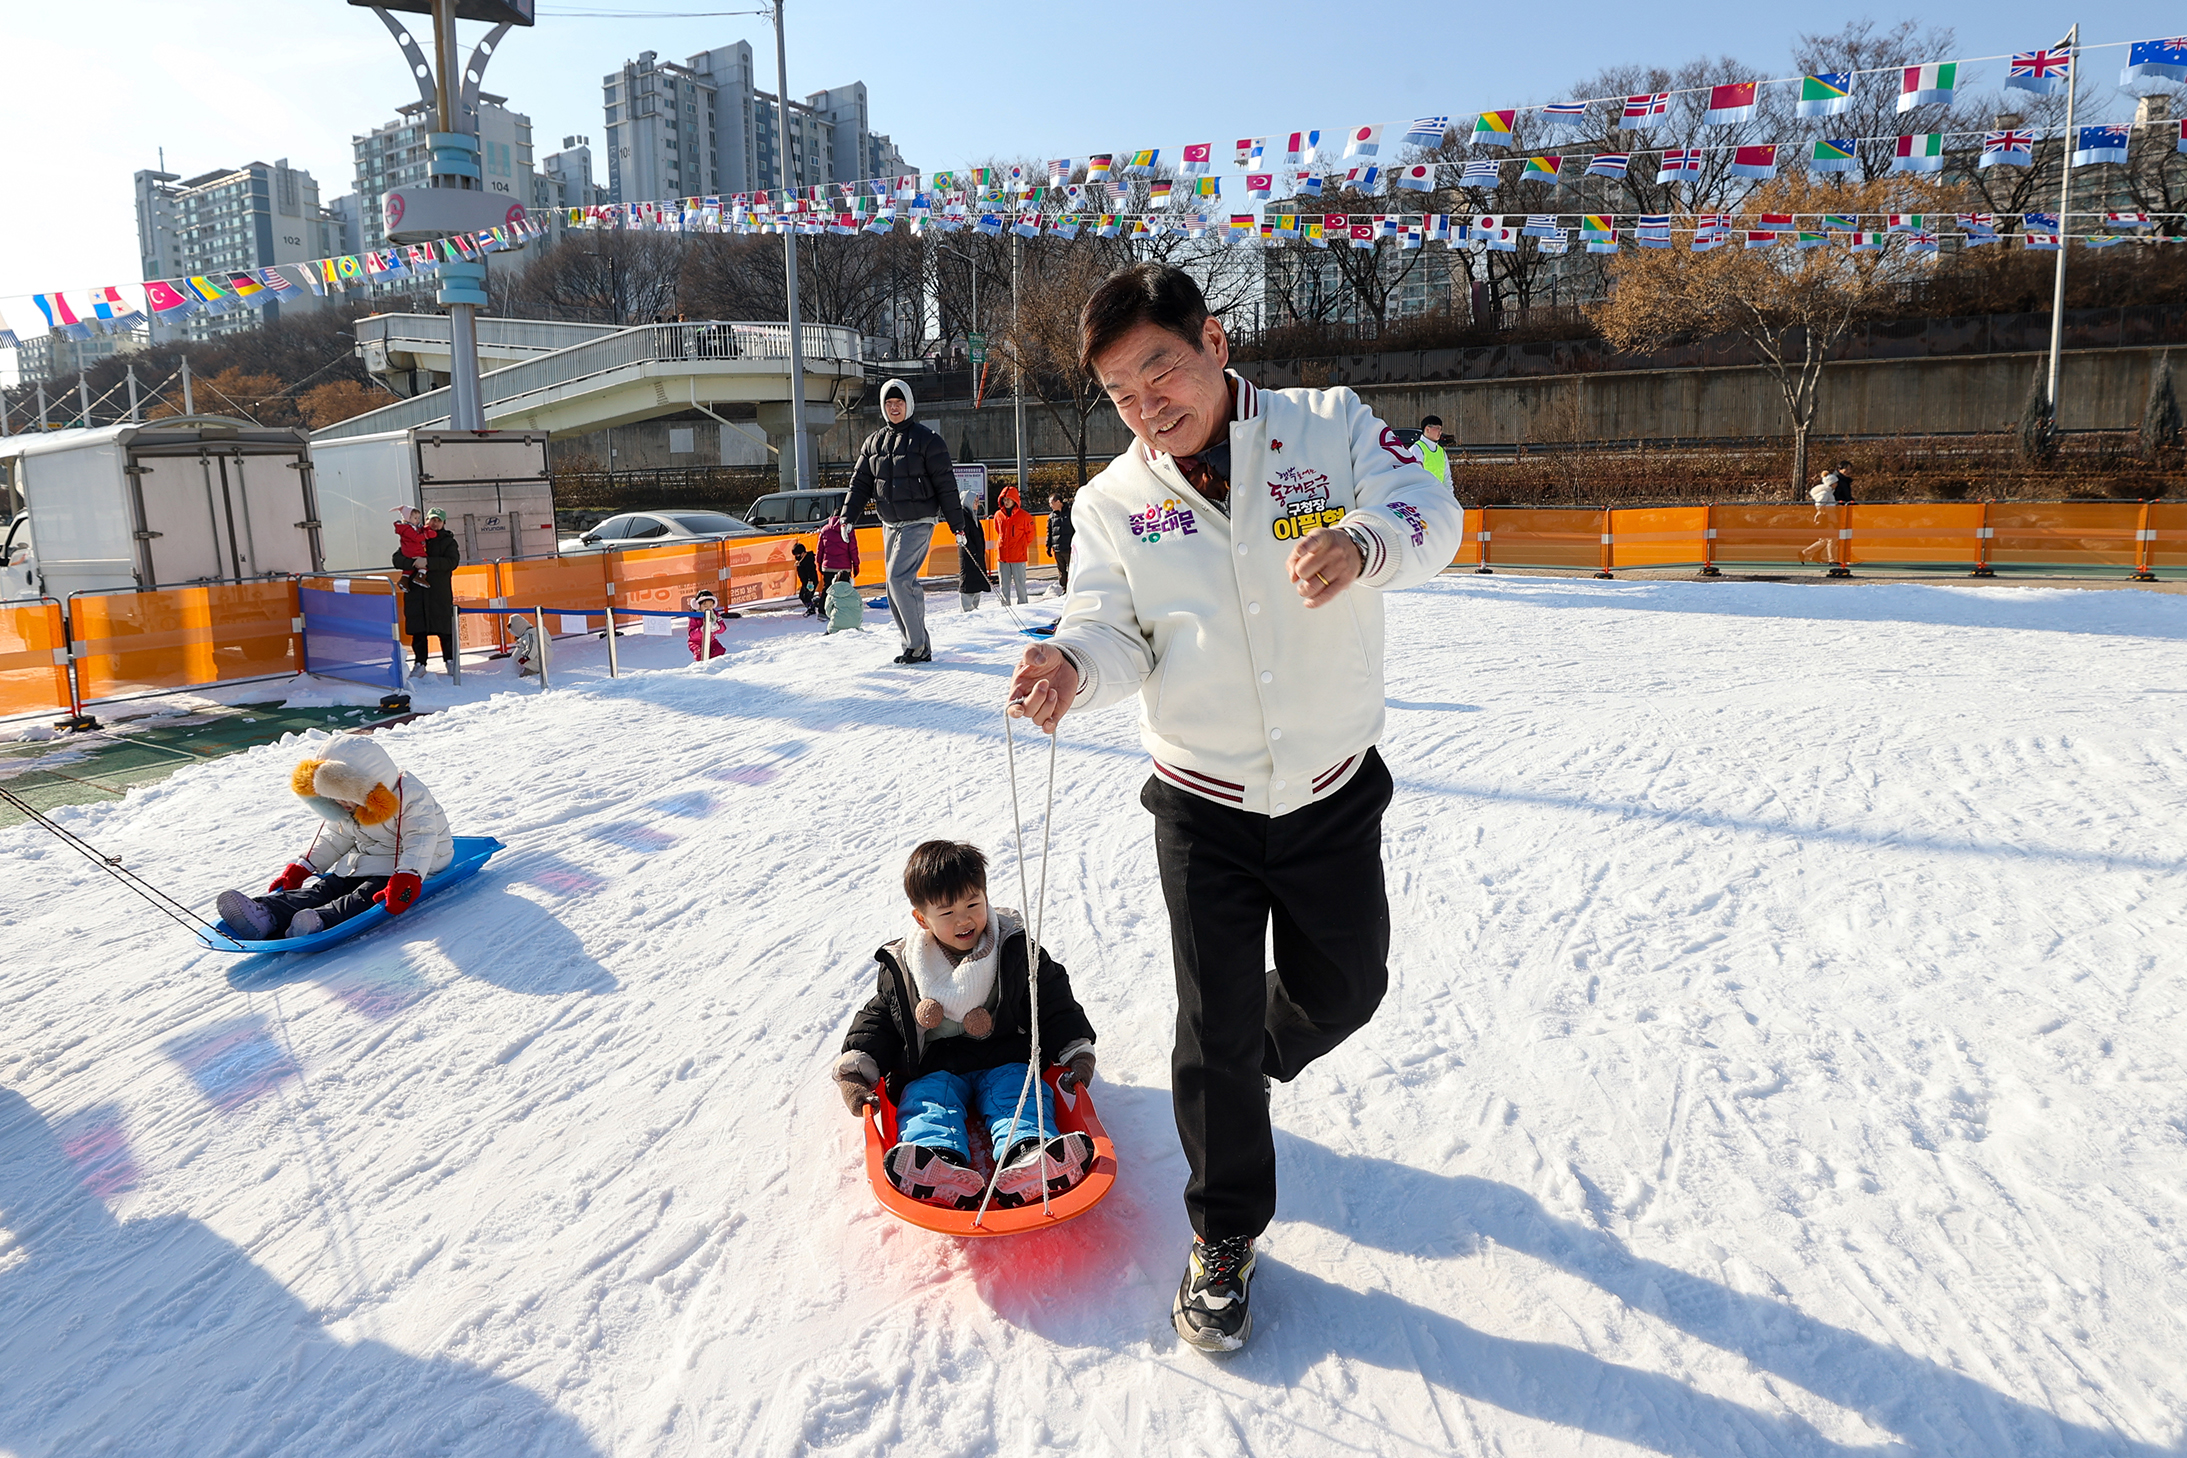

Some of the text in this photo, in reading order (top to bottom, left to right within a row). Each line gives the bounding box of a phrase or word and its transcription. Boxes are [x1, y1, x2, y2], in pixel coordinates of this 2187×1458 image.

[491, 181, 509, 192] 104
[283, 236, 301, 246] 102
[1267, 474, 1330, 507] 동대문구
[1288, 498, 1326, 516] 구청장
